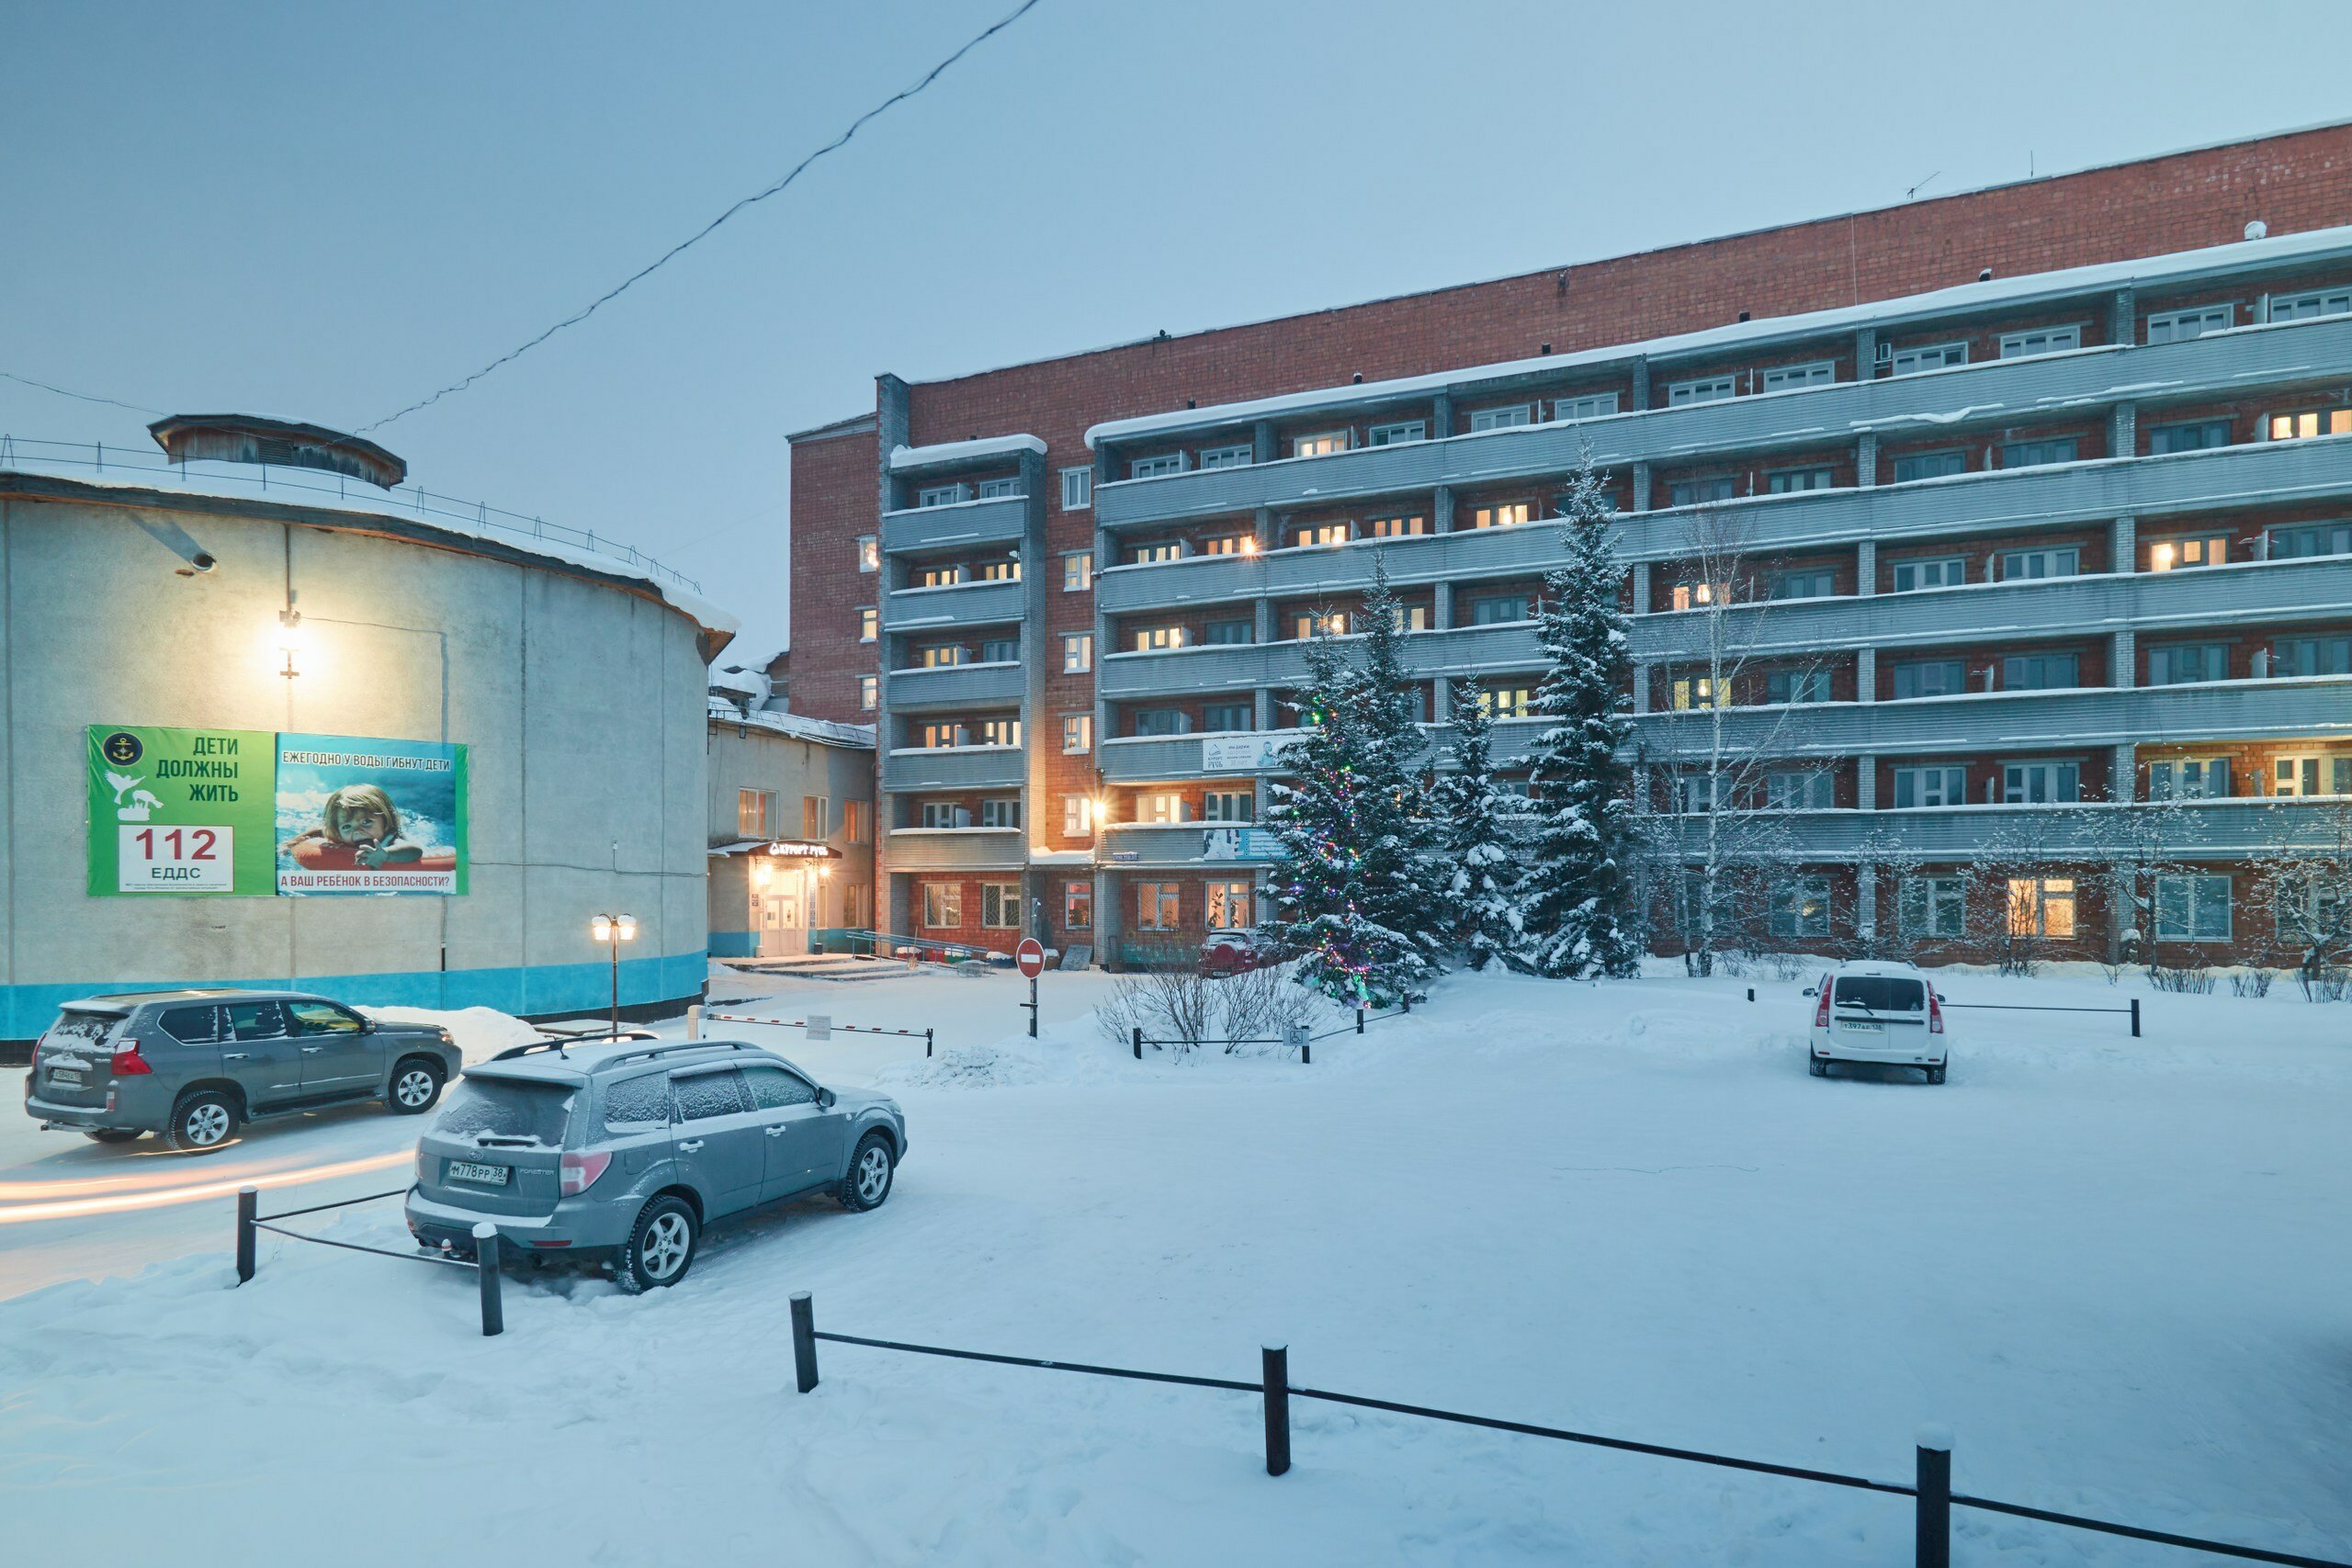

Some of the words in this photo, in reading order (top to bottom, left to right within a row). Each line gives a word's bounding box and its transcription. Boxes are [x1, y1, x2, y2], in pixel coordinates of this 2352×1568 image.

[193, 738, 238, 756] ДЕТИ
[156, 760, 238, 778] ДОЛЖНЫ
[283, 751, 341, 765] ЕЖЕГОДНО
[344, 754, 351, 765] У
[354, 755, 383, 767] ВОДЫ
[386, 757, 423, 769] ГИБНУТ
[425, 759, 449, 771] ДЕТИ
[189, 784, 238, 802] ЖИТЬ
[136, 829, 216, 860] 112
[152, 867, 200, 880] ЕДДС
[281, 875, 288, 886] А
[290, 875, 313, 886] ВАШ
[317, 874, 361, 886] РЕБЁНОК
[364, 876, 370, 886] В
[373, 875, 449, 886] БЕЗОПАСНОСТИ?
